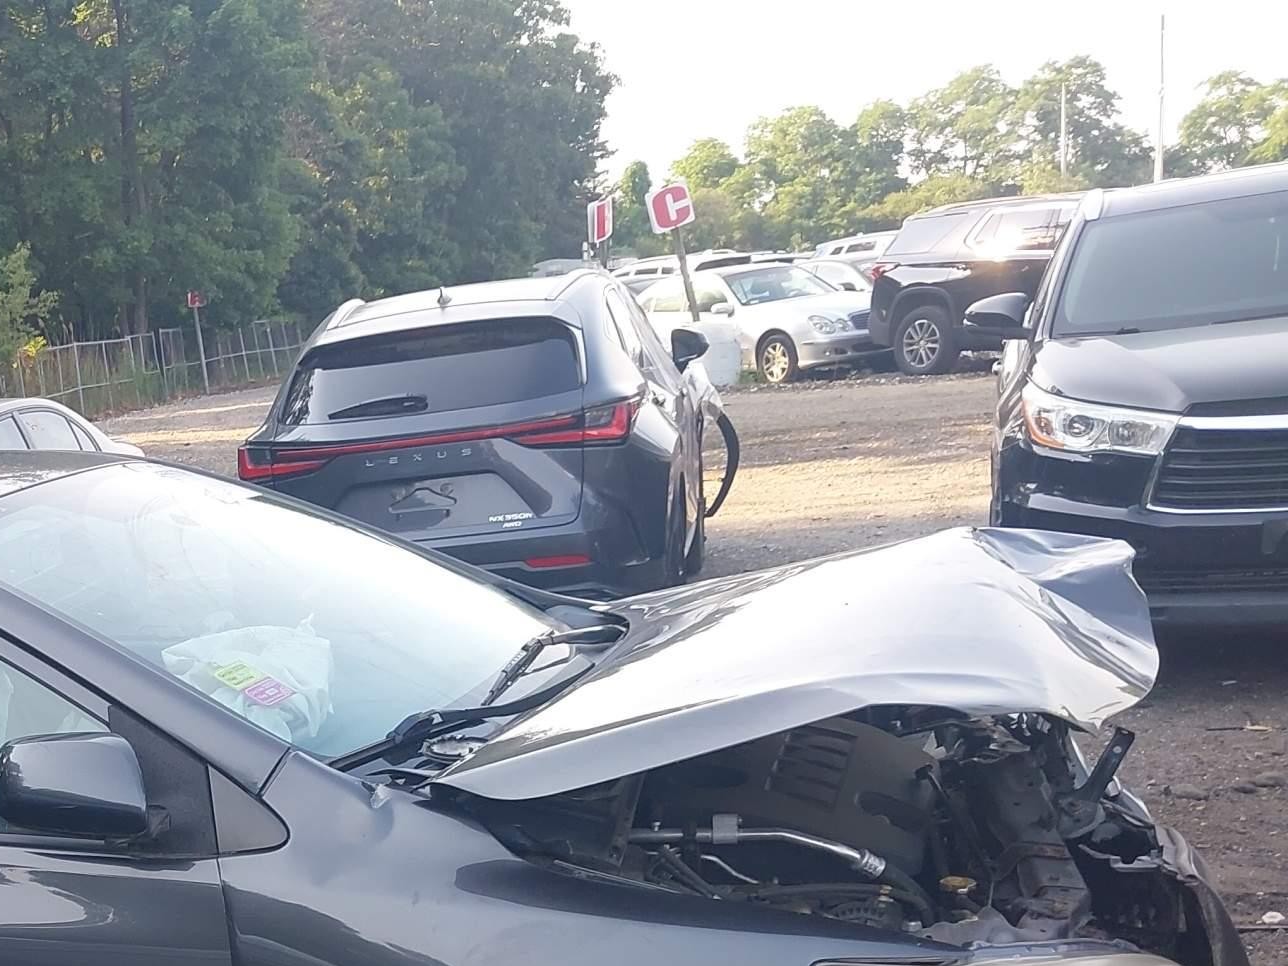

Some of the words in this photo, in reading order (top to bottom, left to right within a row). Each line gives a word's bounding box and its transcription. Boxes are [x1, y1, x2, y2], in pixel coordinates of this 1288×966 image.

[652, 186, 691, 229] C
[365, 448, 473, 467] LEXUS
[489, 514, 504, 523] NX
